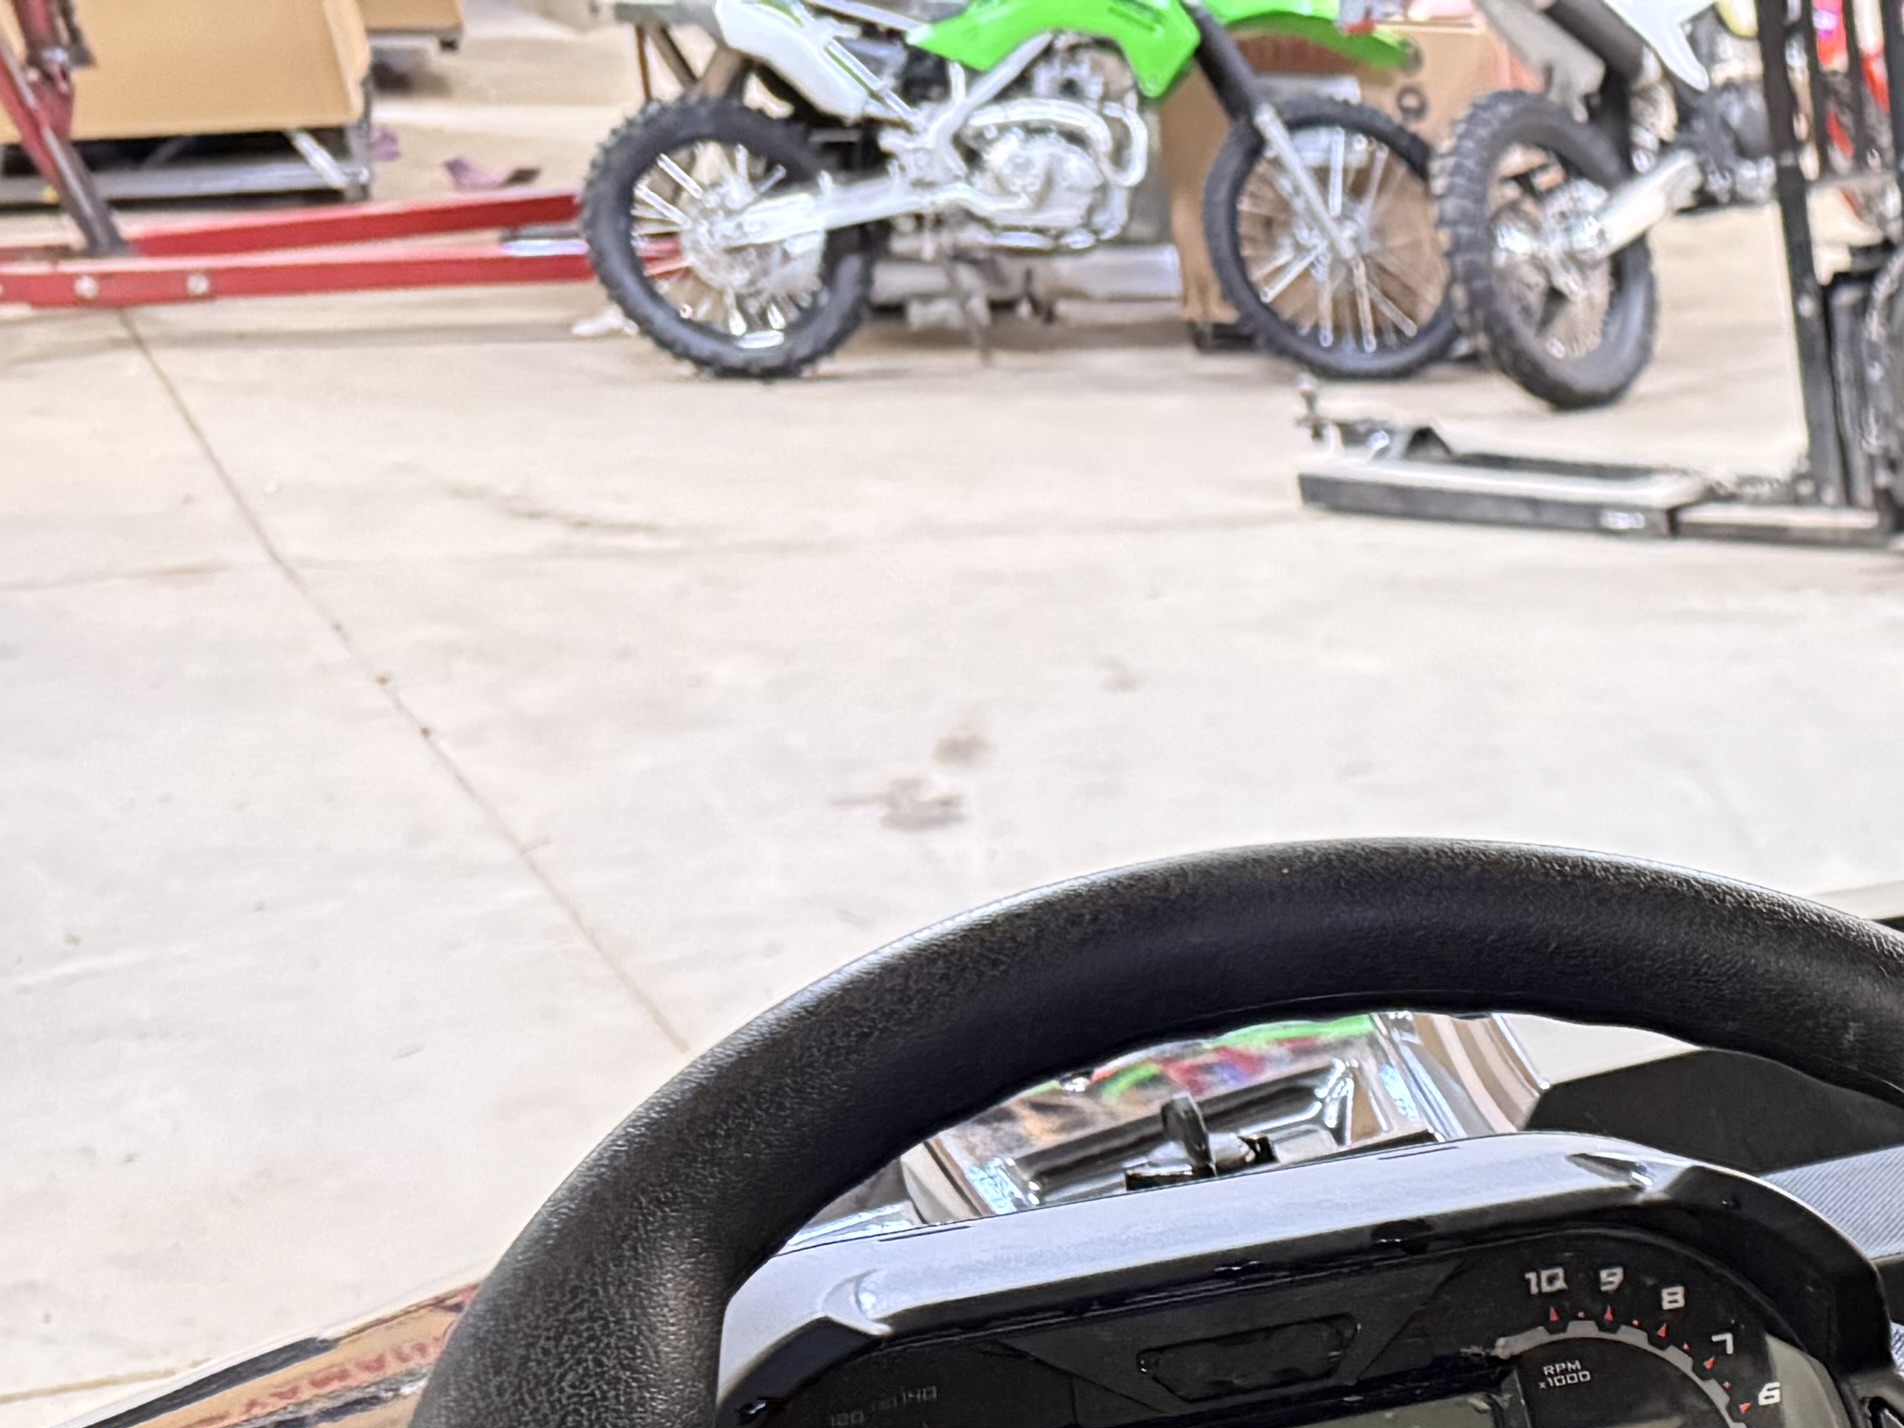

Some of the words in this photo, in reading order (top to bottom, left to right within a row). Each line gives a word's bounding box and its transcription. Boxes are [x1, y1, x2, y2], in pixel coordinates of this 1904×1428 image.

[1600, 1266, 1624, 1291] 9
[1661, 1285, 1686, 1310] 8
[1711, 1332, 1734, 1354] 7
[1543, 1360, 1582, 1376] RPM
[1758, 1382, 1781, 1406] 6
